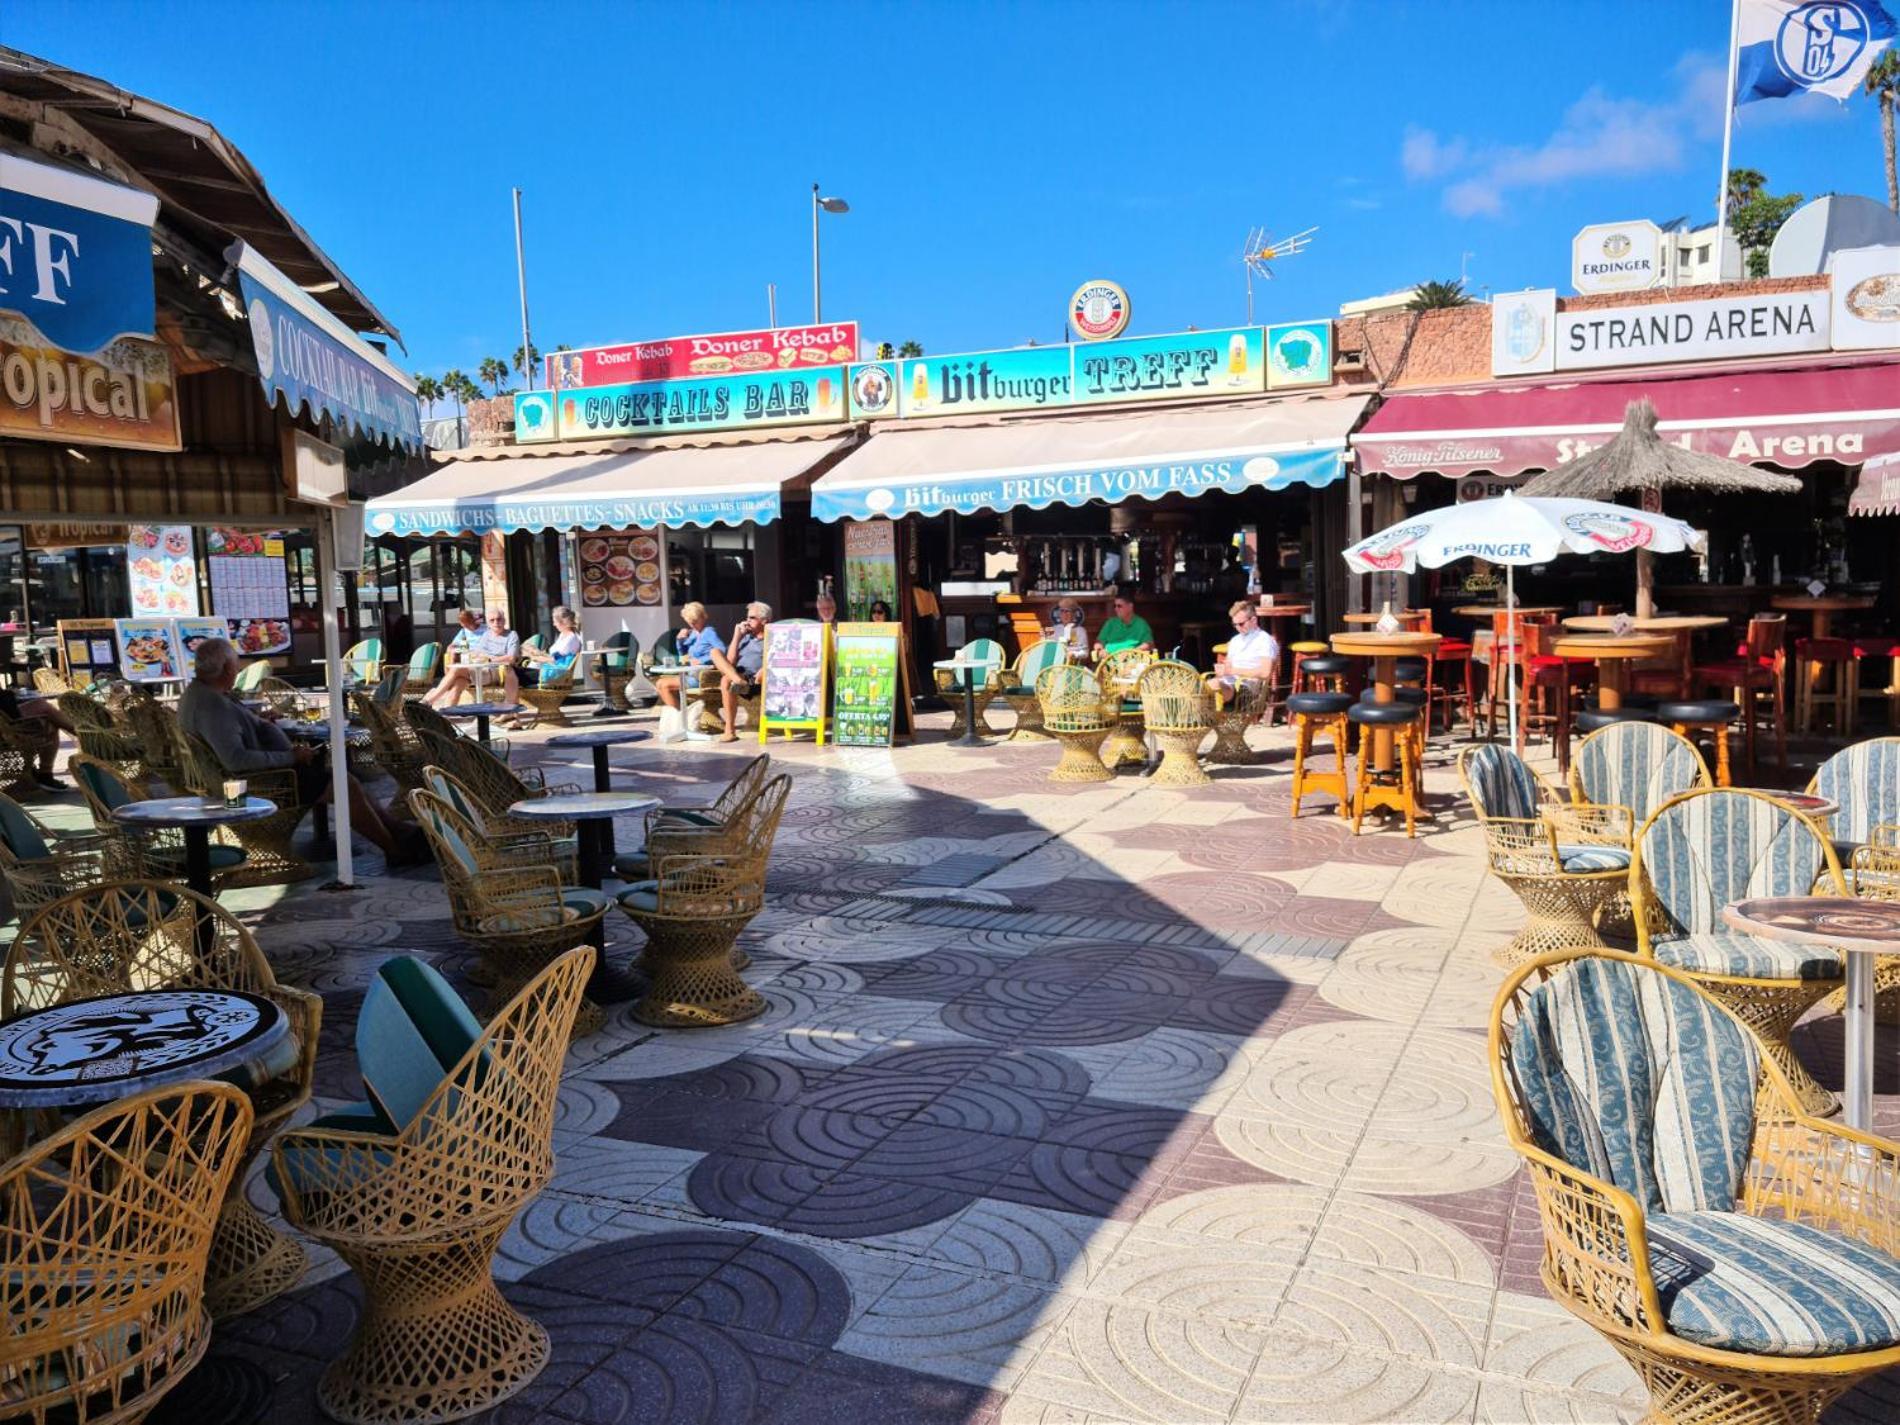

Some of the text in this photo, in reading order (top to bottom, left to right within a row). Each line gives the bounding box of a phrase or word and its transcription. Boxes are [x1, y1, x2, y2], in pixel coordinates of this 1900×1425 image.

[1807, 45, 1832, 75] 04
[1582, 260, 1651, 275] ERDINGER
[1076, 287, 1121, 308] ERDINGER
[690, 325, 848, 359] Doner Kebab
[1570, 313, 1693, 352] STRAND
[1705, 303, 1815, 341] ARENA
[278, 315, 338, 400] COCKTAIL
[635, 344, 674, 361] Kebab
[0, 345, 150, 430] opical
[1083, 347, 1218, 394] TREFF
[585, 386, 730, 430] COCKTAILS
[744, 380, 810, 418] BAR
[1727, 429, 1864, 459] Arena
[1001, 474, 1092, 501] FRISCH
[1100, 468, 1160, 493] VOM
[1169, 462, 1232, 487] FASS
[1443, 543, 1532, 558] ERDINGER
